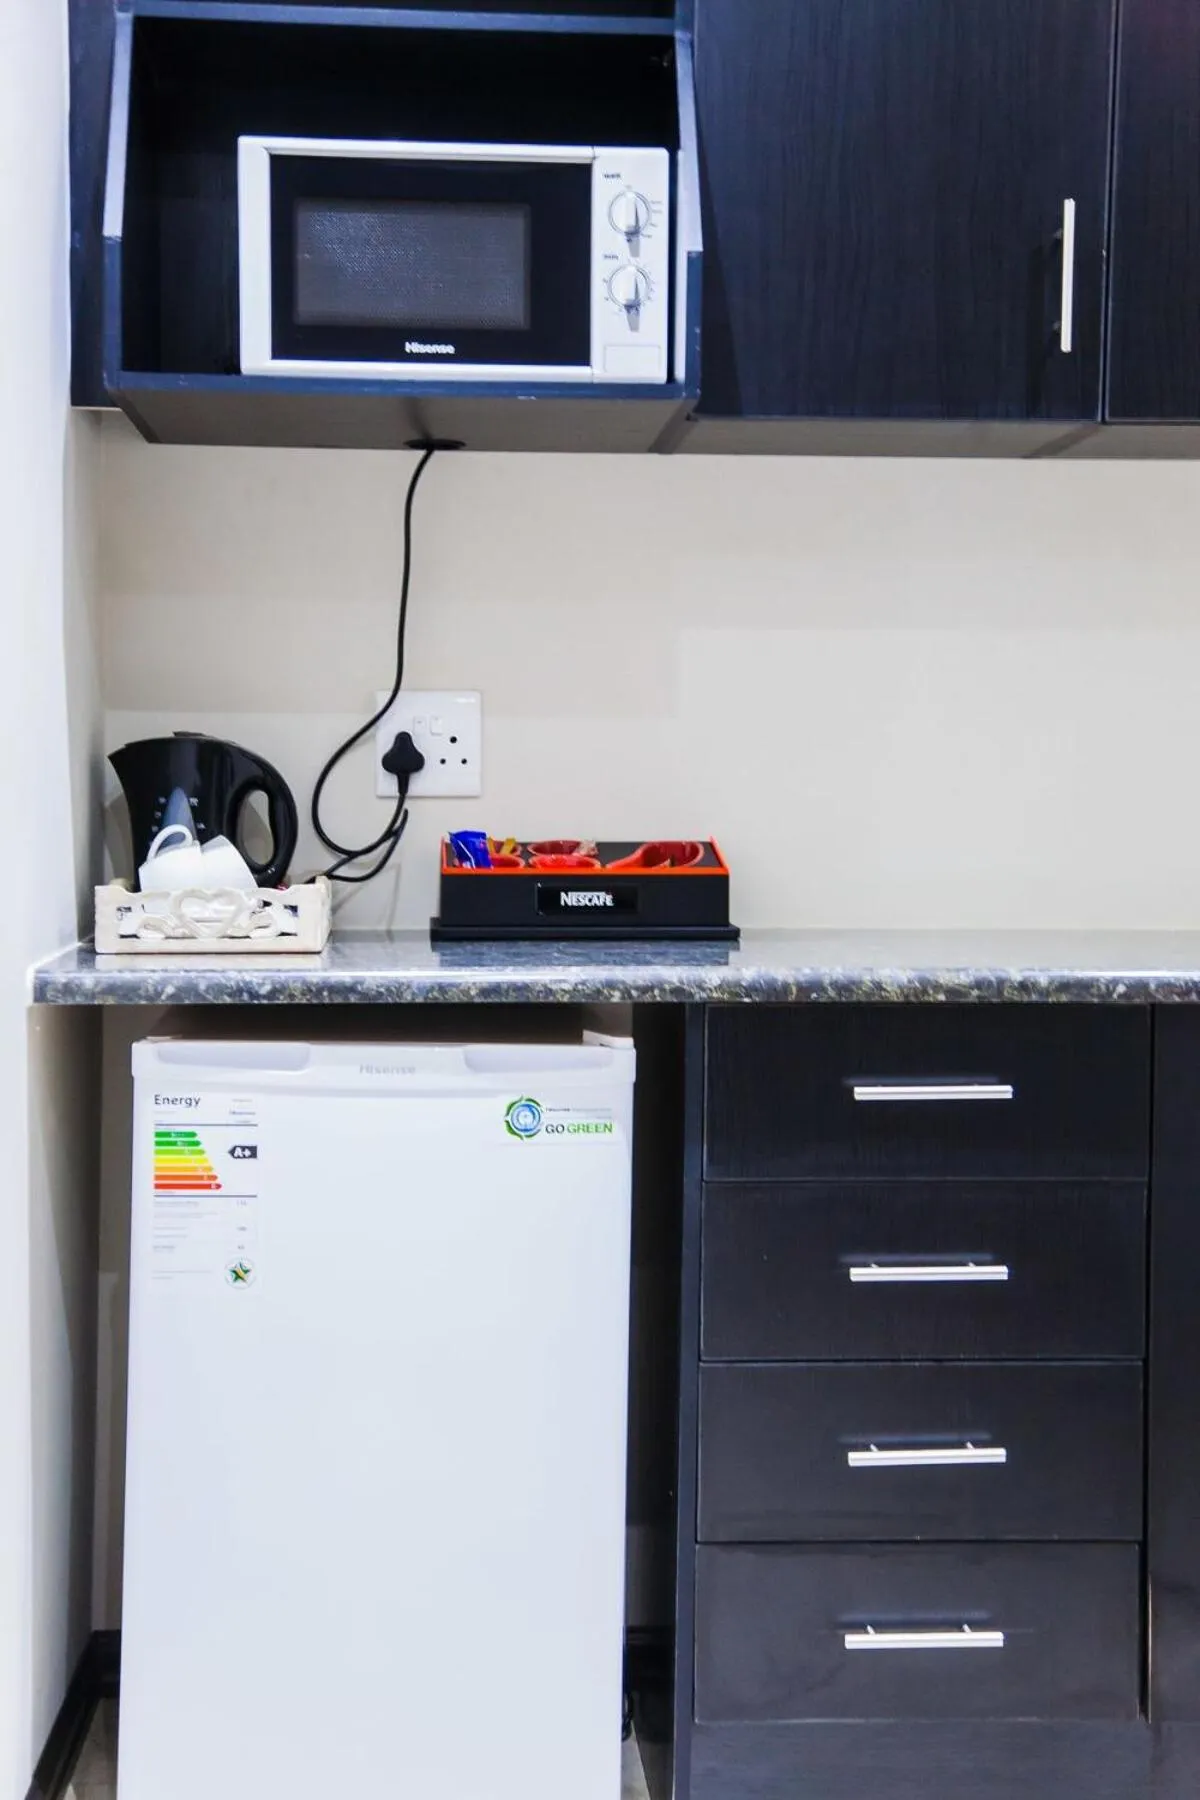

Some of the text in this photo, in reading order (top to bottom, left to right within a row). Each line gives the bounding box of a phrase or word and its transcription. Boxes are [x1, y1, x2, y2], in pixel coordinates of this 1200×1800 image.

[154, 1094, 201, 1108] Energy
[545, 1123, 613, 1134] GO GREEN
